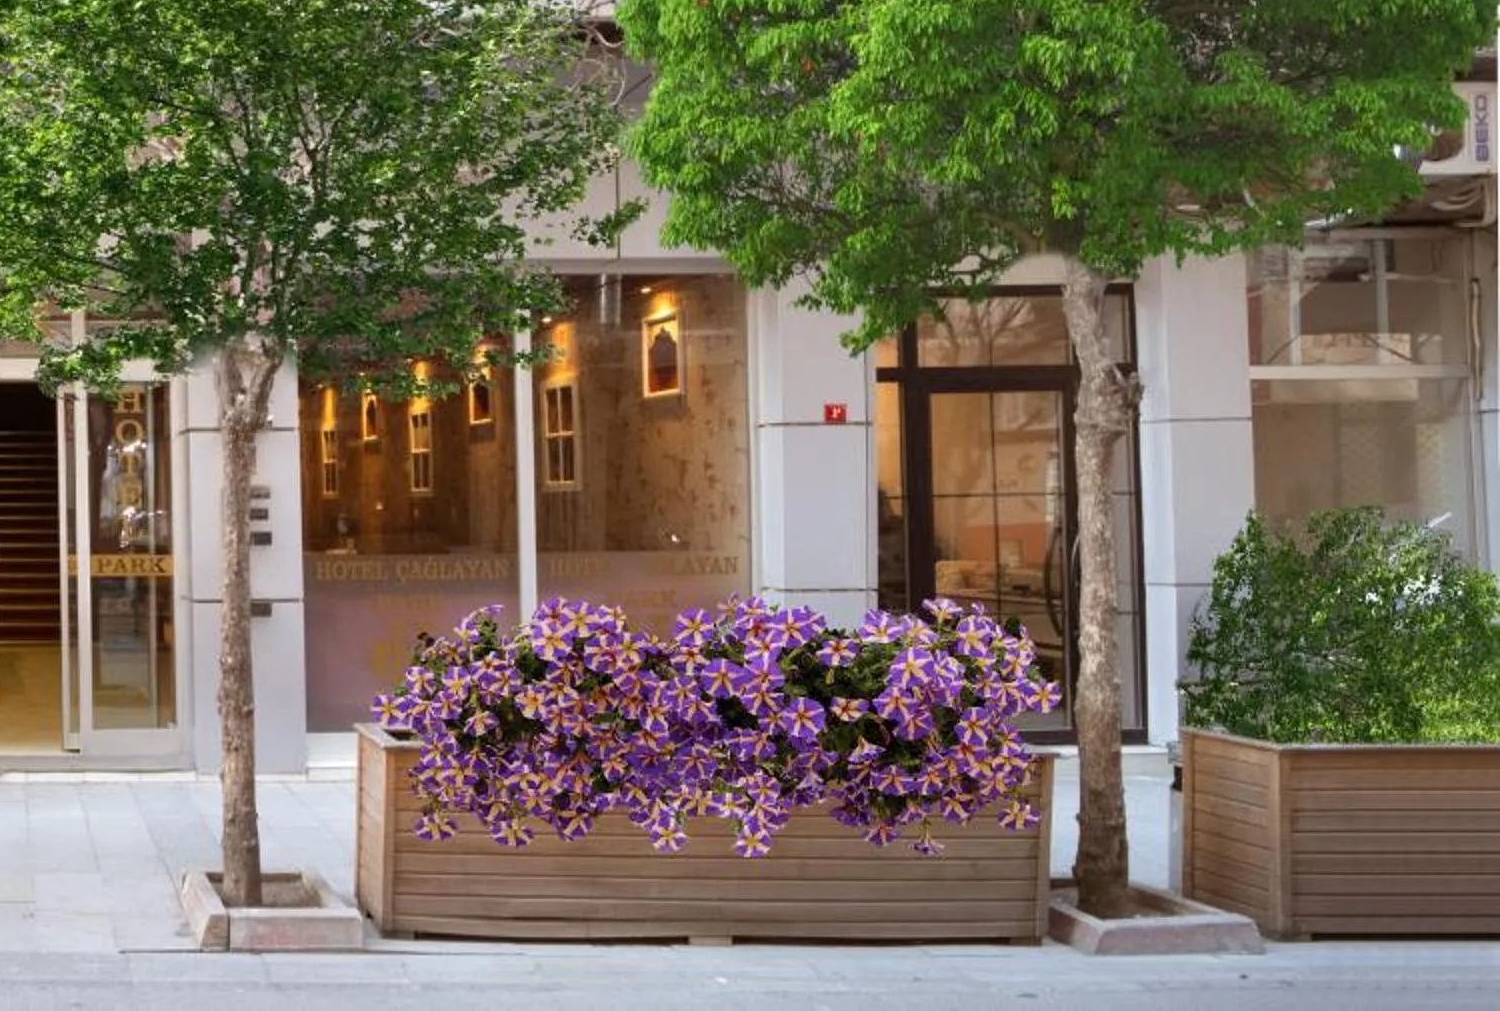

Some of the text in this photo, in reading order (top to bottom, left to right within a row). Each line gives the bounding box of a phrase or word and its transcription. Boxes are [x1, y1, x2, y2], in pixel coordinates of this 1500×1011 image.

[1475, 94, 1488, 162] BEKO
[98, 558, 166, 574] PARK
[316, 561, 389, 581] HOTEL
